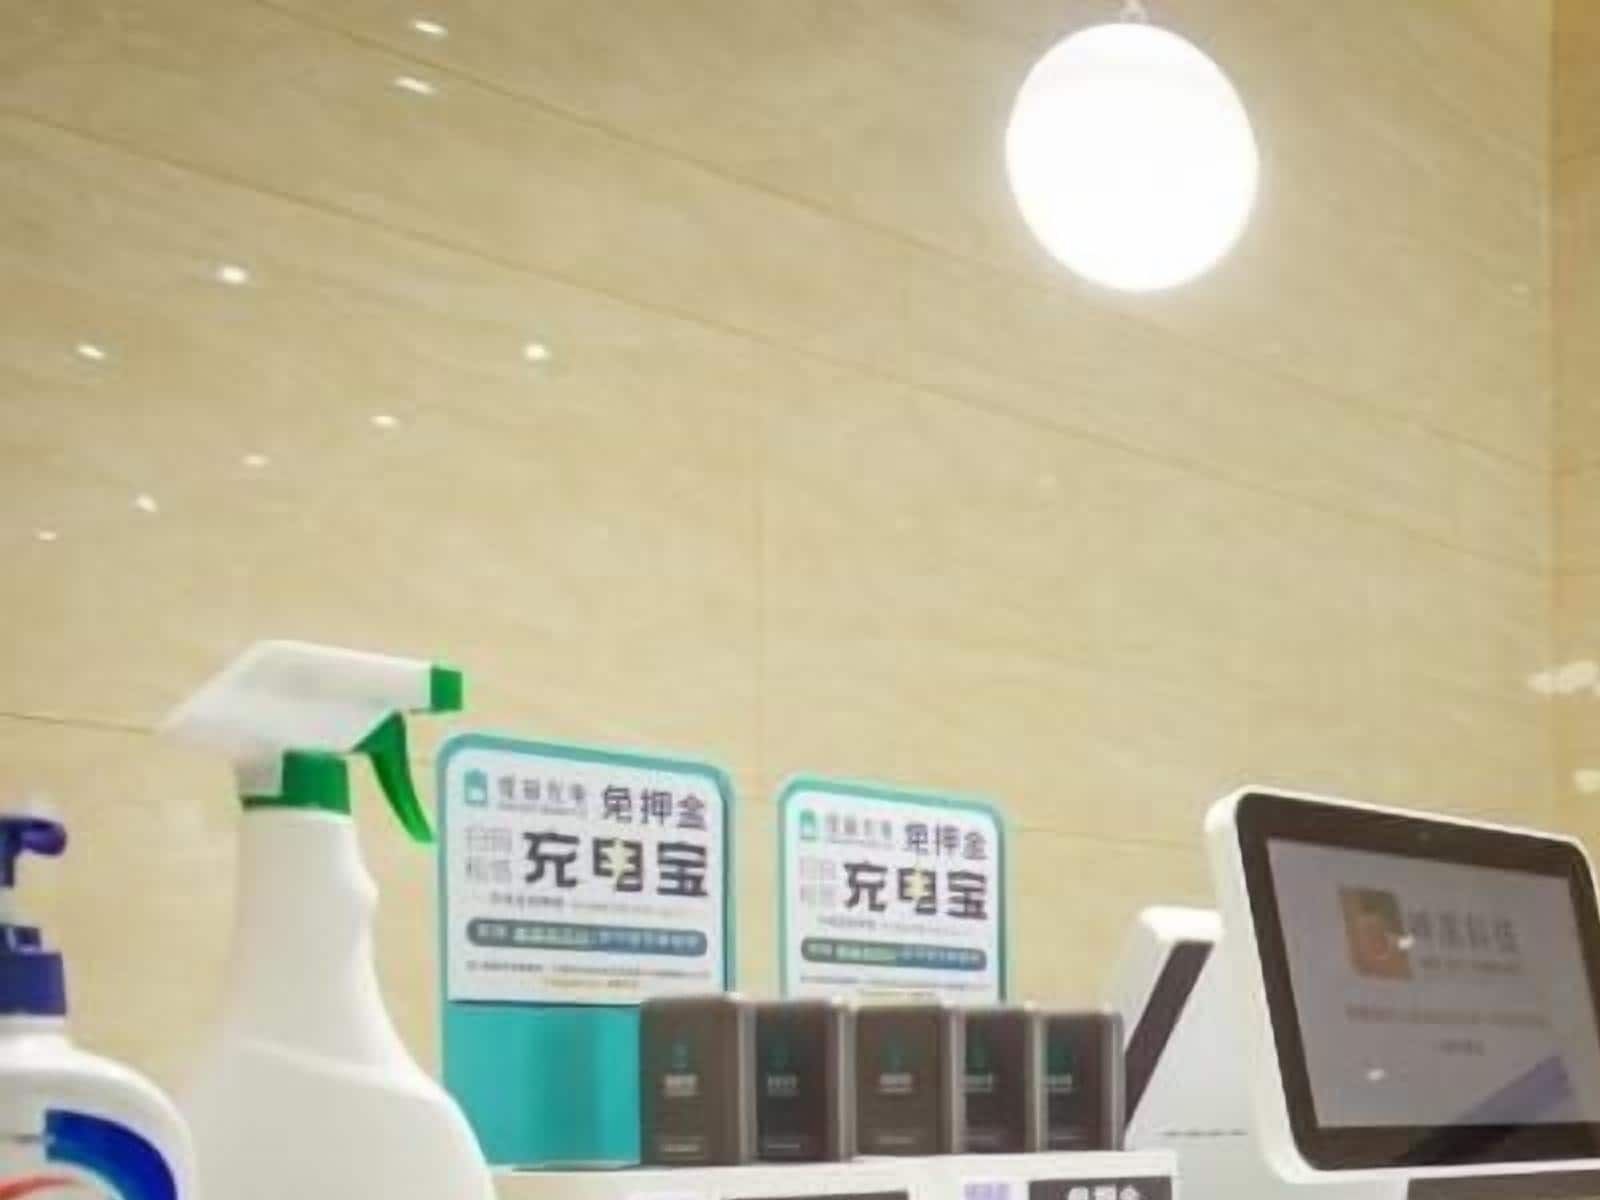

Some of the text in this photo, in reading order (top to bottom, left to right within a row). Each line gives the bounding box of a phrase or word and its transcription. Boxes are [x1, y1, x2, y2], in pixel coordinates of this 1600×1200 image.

[602, 784, 705, 830] 免押金
[523, 832, 708, 897] 充电宝
[843, 860, 988, 921] 充电宝
